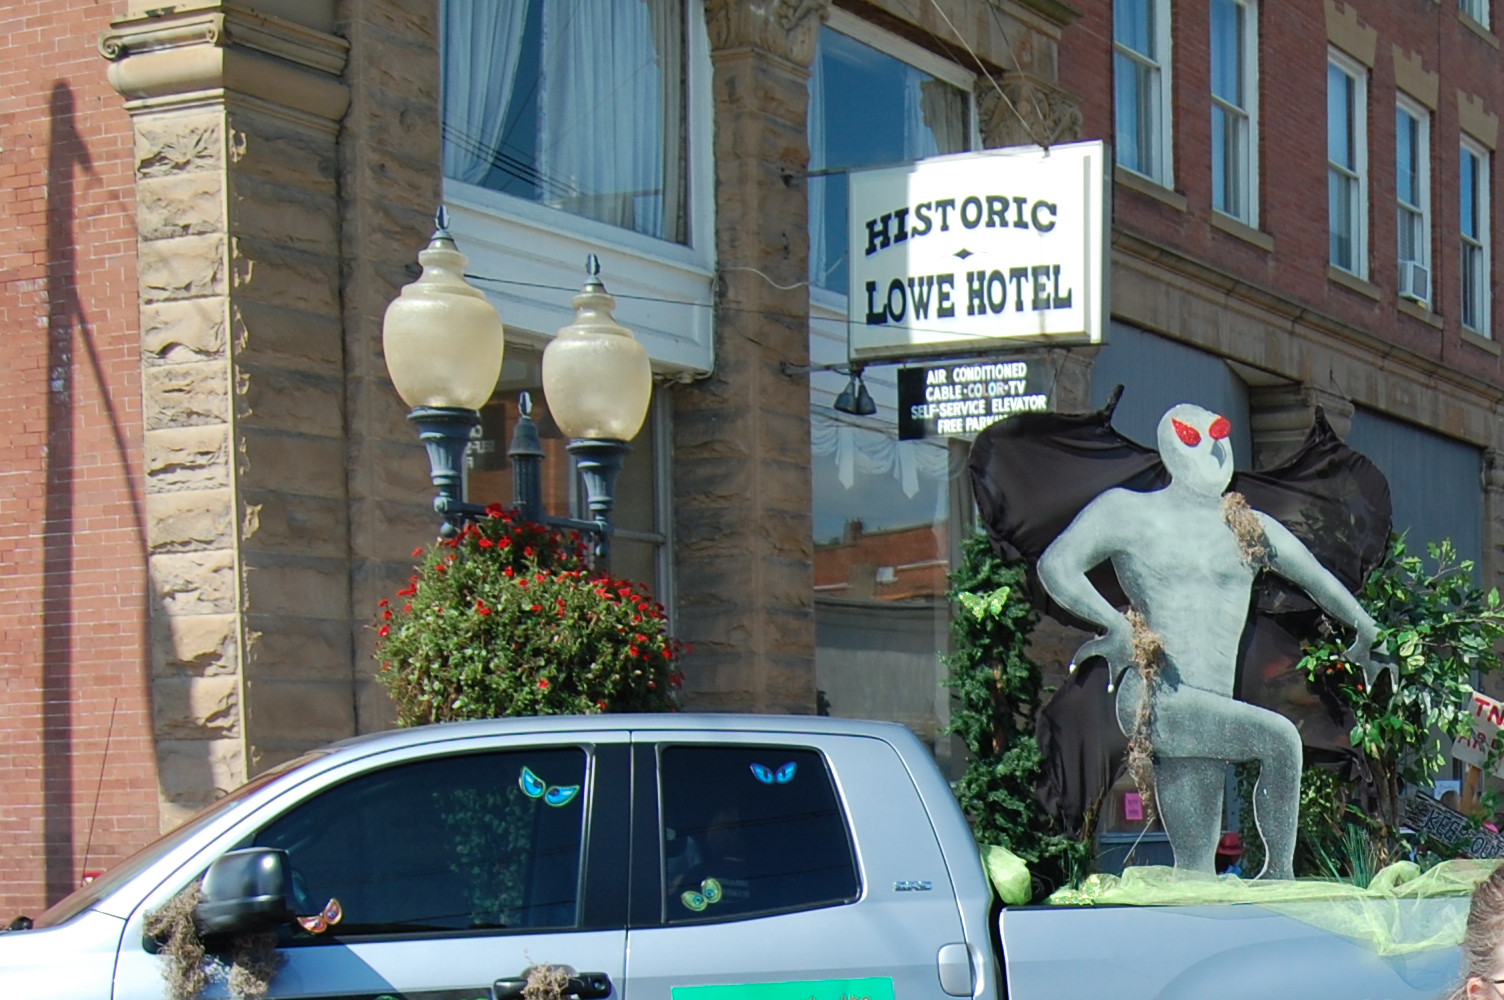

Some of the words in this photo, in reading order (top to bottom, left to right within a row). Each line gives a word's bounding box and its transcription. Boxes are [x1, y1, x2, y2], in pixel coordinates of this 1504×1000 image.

[865, 195, 1057, 256] HISTORIC
[866, 273, 955, 325] LOWE
[967, 264, 1072, 316] HOTEL
[926, 369, 947, 385] AIR
[953, 362, 1028, 382] CONDITIONED
[911, 400, 986, 419] SELF-SERVICE
[991, 394, 1048, 413] ELEVATOR
[937, 418, 963, 434] FREE
